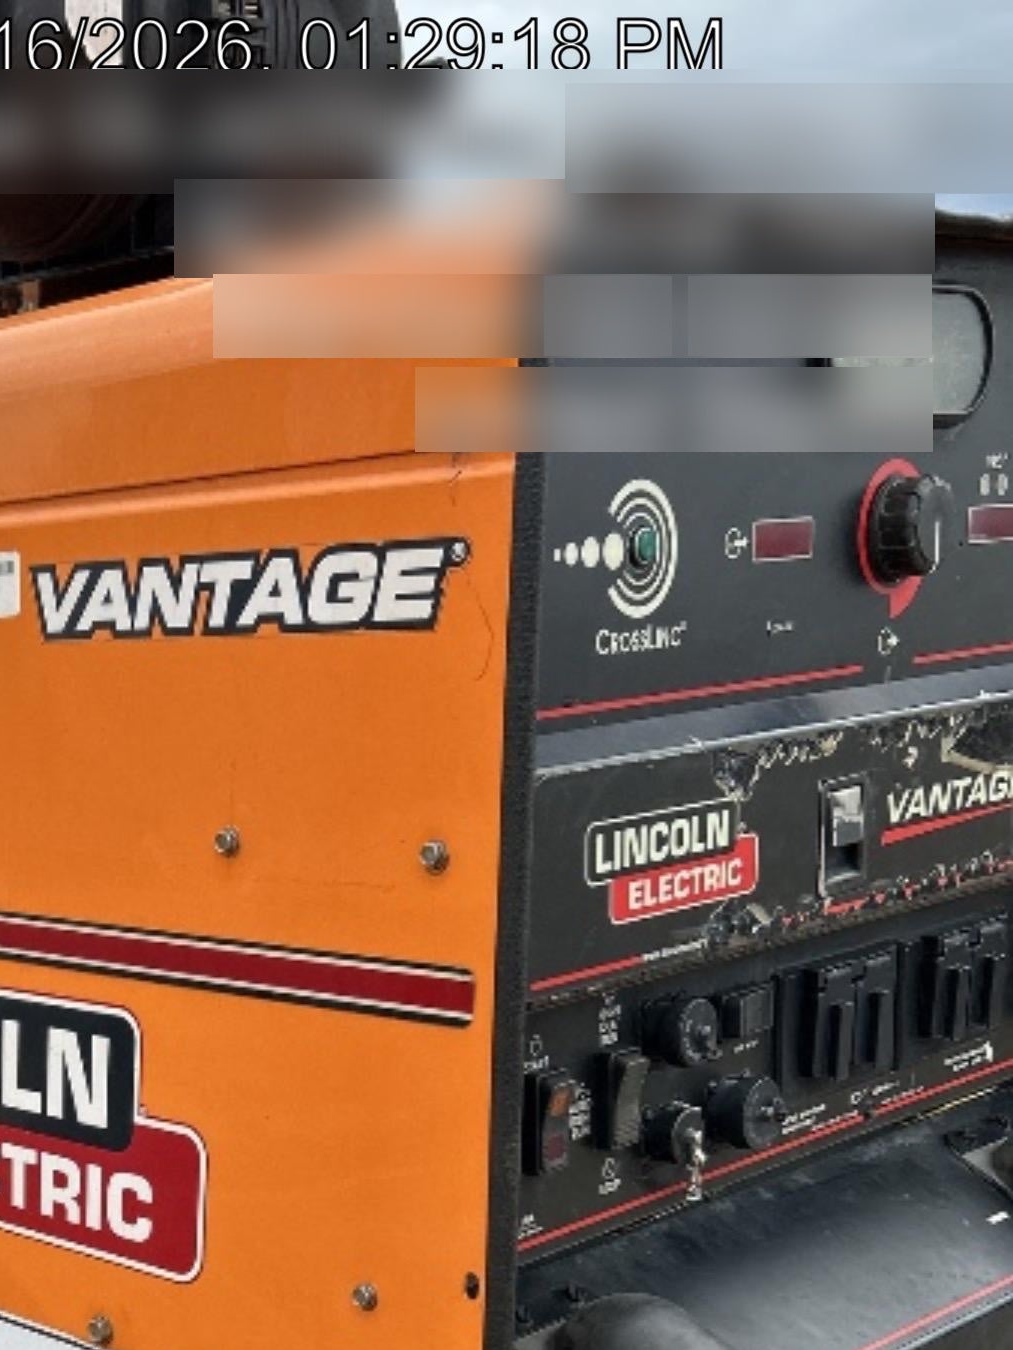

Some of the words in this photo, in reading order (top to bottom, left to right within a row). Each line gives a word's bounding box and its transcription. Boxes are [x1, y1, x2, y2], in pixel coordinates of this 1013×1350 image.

[887, 770, 1013, 823] VANTAG
[595, 809, 730, 874] LINCOLN
[628, 857, 742, 911] ELECTRIC
